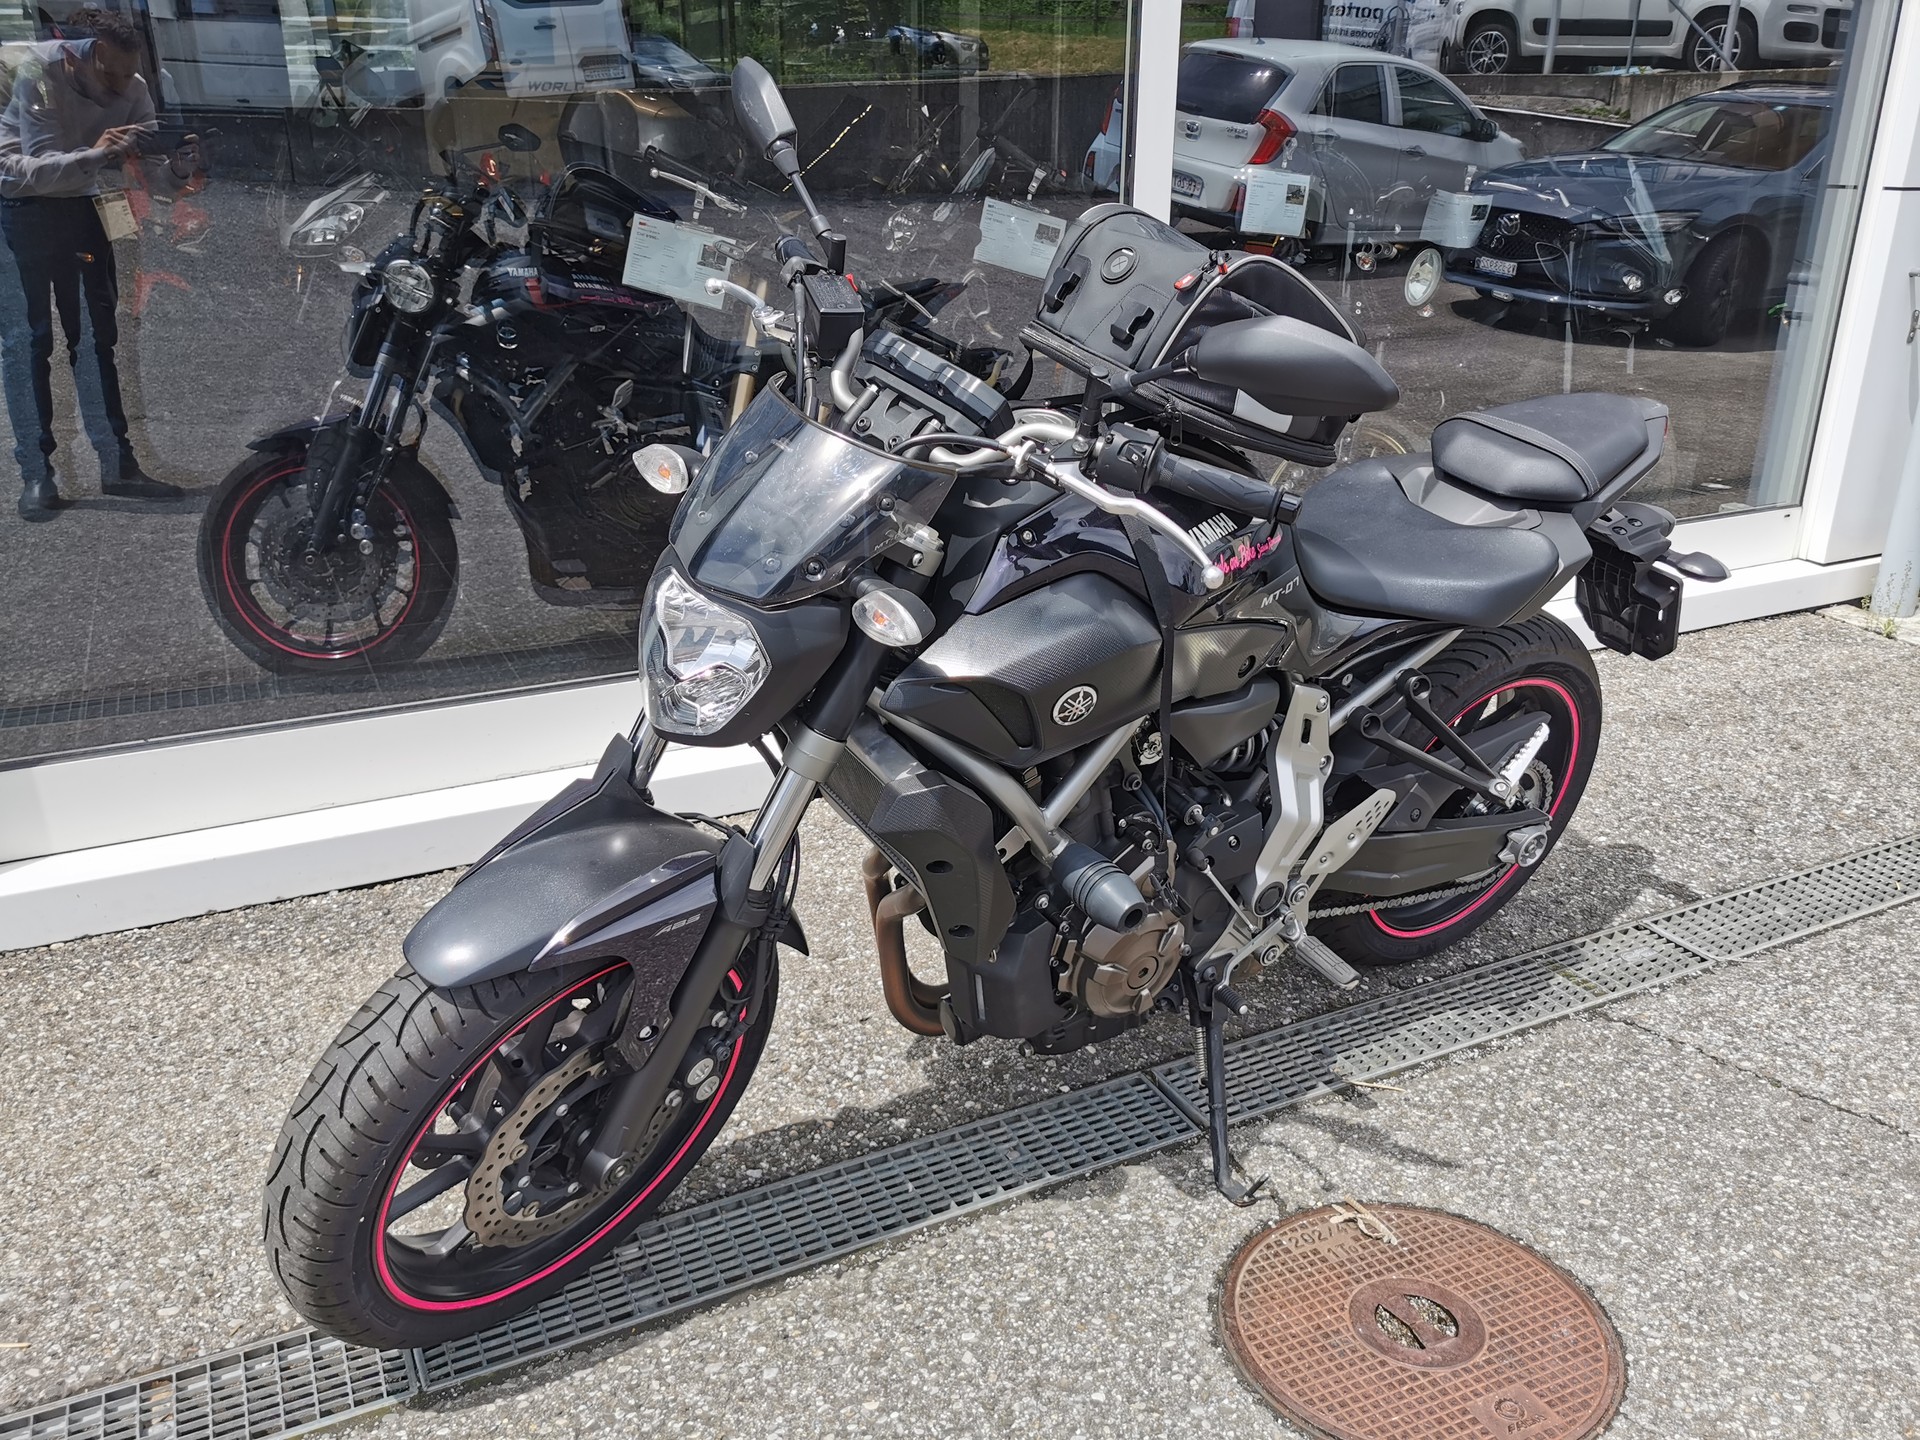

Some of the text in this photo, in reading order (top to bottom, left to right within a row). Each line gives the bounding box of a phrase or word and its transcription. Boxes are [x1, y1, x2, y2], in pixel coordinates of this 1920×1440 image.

[507, 267, 538, 277] YAMAHA
[1188, 512, 1238, 549] YAMAHA
[1261, 576, 1299, 608] MT-07
[654, 914, 701, 937] ABS
